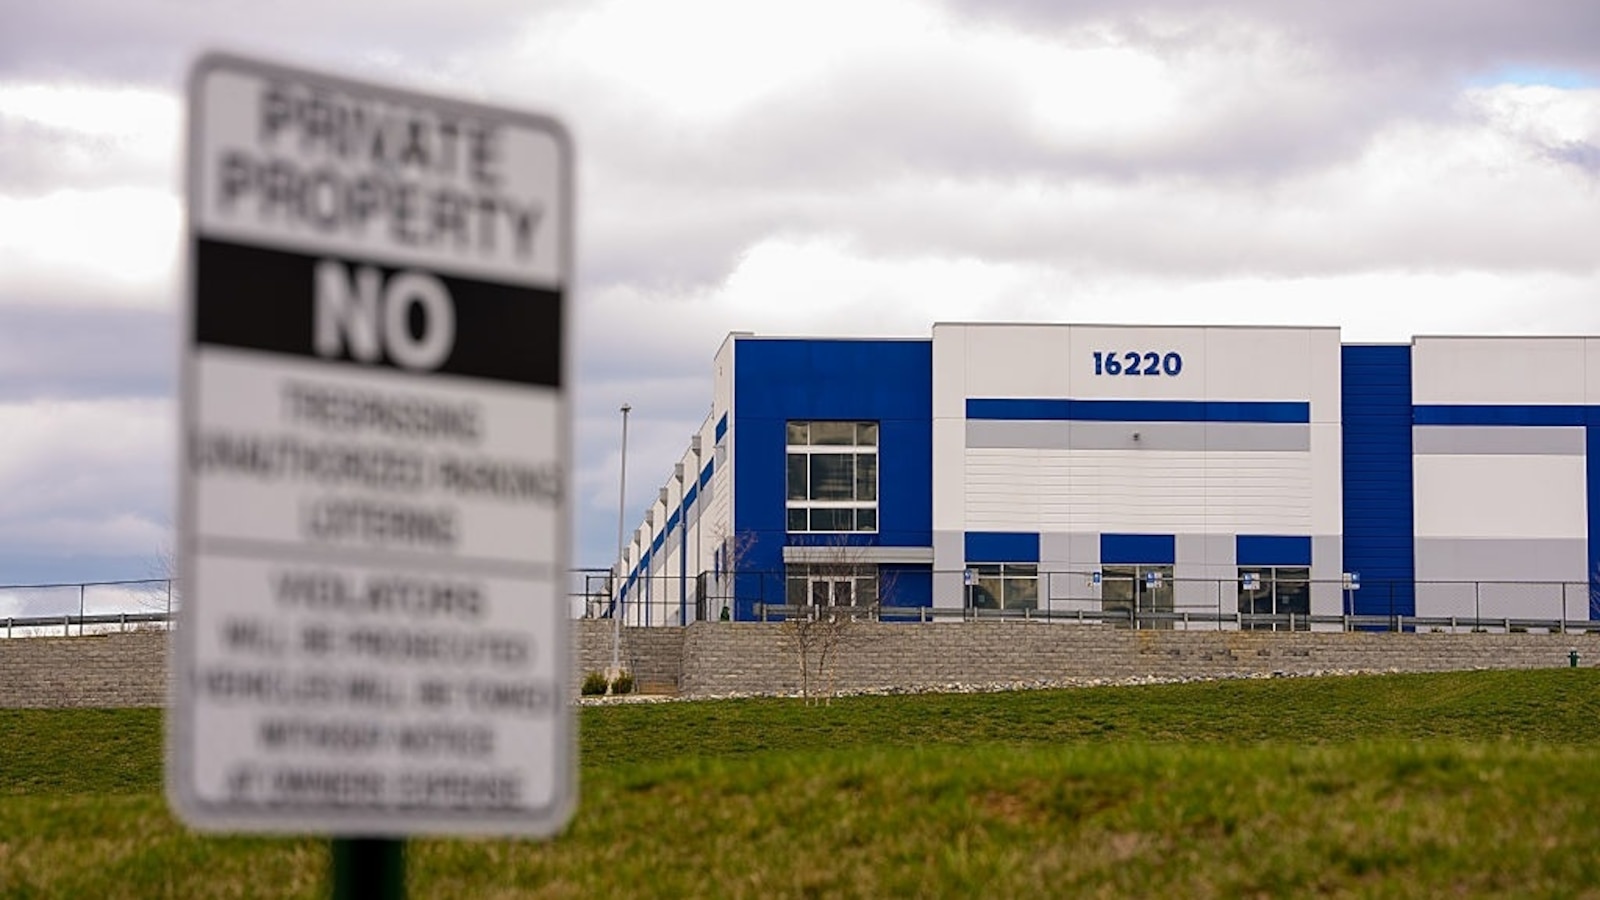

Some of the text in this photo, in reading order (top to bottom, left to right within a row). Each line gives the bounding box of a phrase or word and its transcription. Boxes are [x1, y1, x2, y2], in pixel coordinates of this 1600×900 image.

[260, 84, 506, 188] PRIVATE
[217, 150, 548, 264] PROPERTY
[316, 261, 454, 370] NO
[1092, 351, 1183, 377] 16220
[282, 381, 486, 447] TRESPASSING
[191, 431, 568, 509] UNAUTHORIZED PARKING
[302, 495, 461, 553] LOITERING
[272, 570, 491, 622] VIOLATORS
[221, 618, 533, 669] WILL BE PROSECUTED
